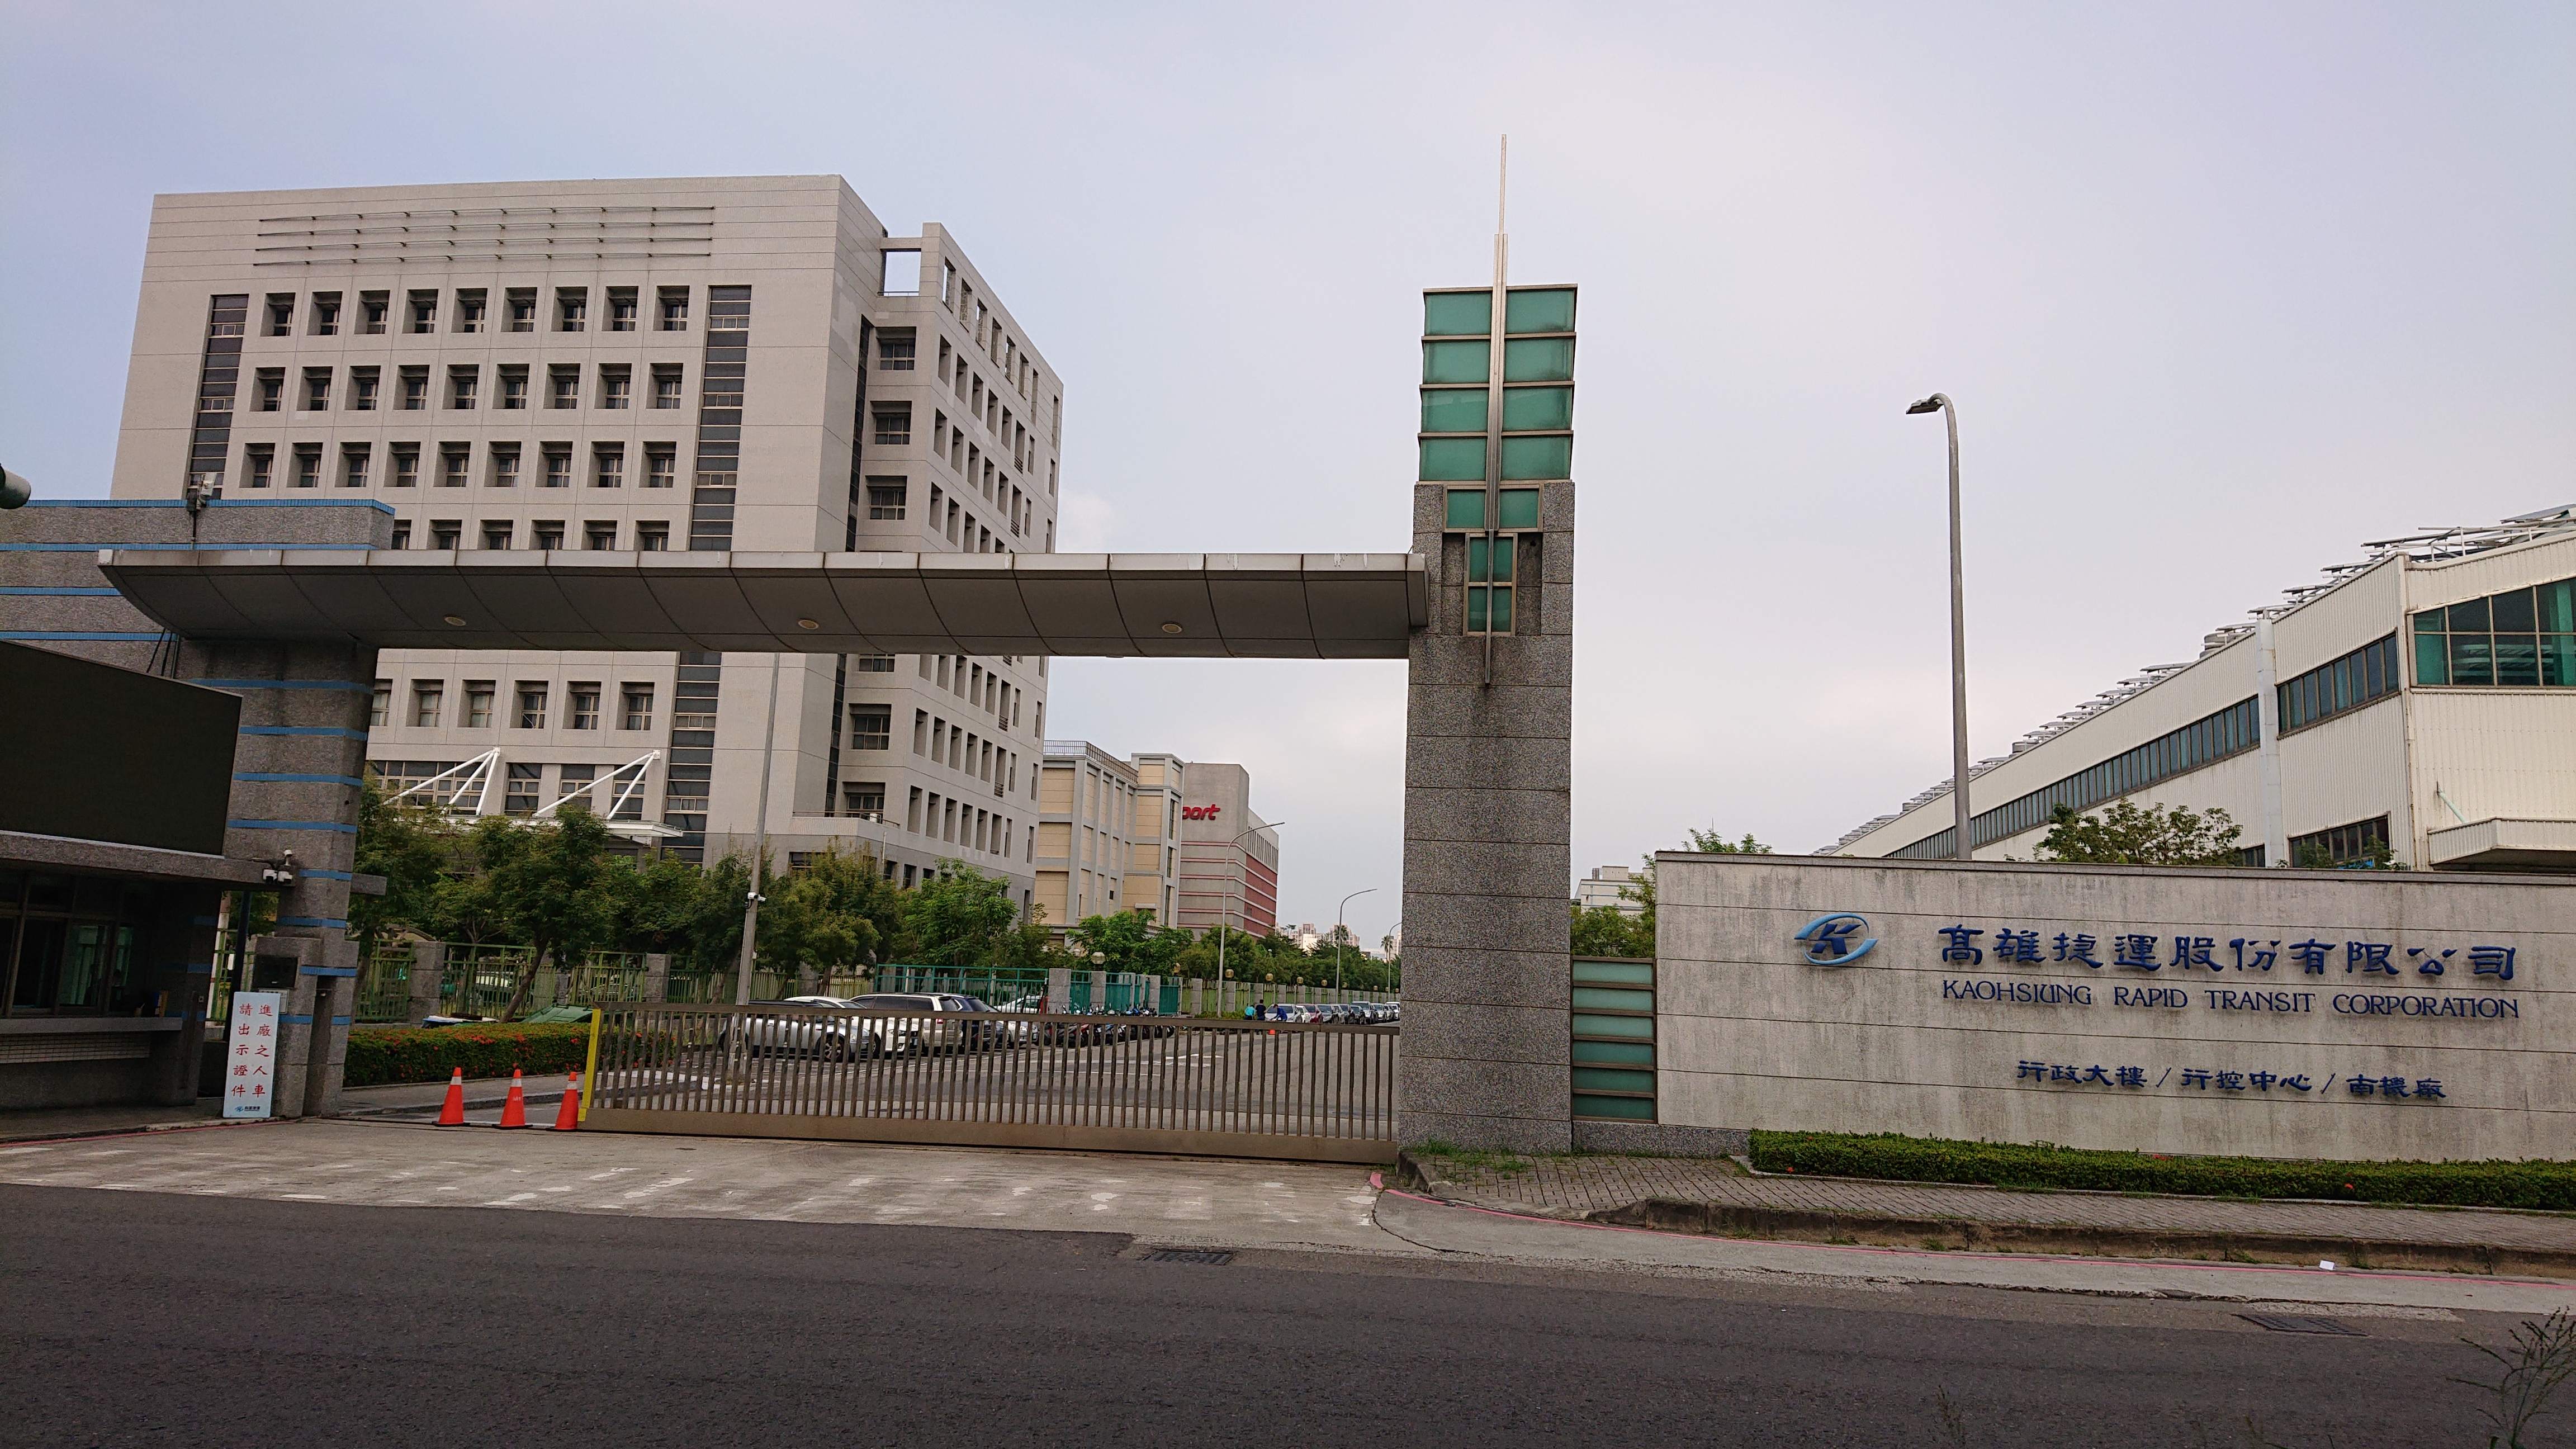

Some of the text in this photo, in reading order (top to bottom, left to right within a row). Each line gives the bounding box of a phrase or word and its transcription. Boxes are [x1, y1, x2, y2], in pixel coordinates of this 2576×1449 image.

[1938, 924, 2516, 980] 高雄捷運股份有限公司
[1943, 980, 2518, 1018] KAOHSIUNG RAPID TRANSIT CORPORATION
[231, 1003, 253, 1098] 請出示證件
[252, 1004, 273, 1098] 進廠之人車
